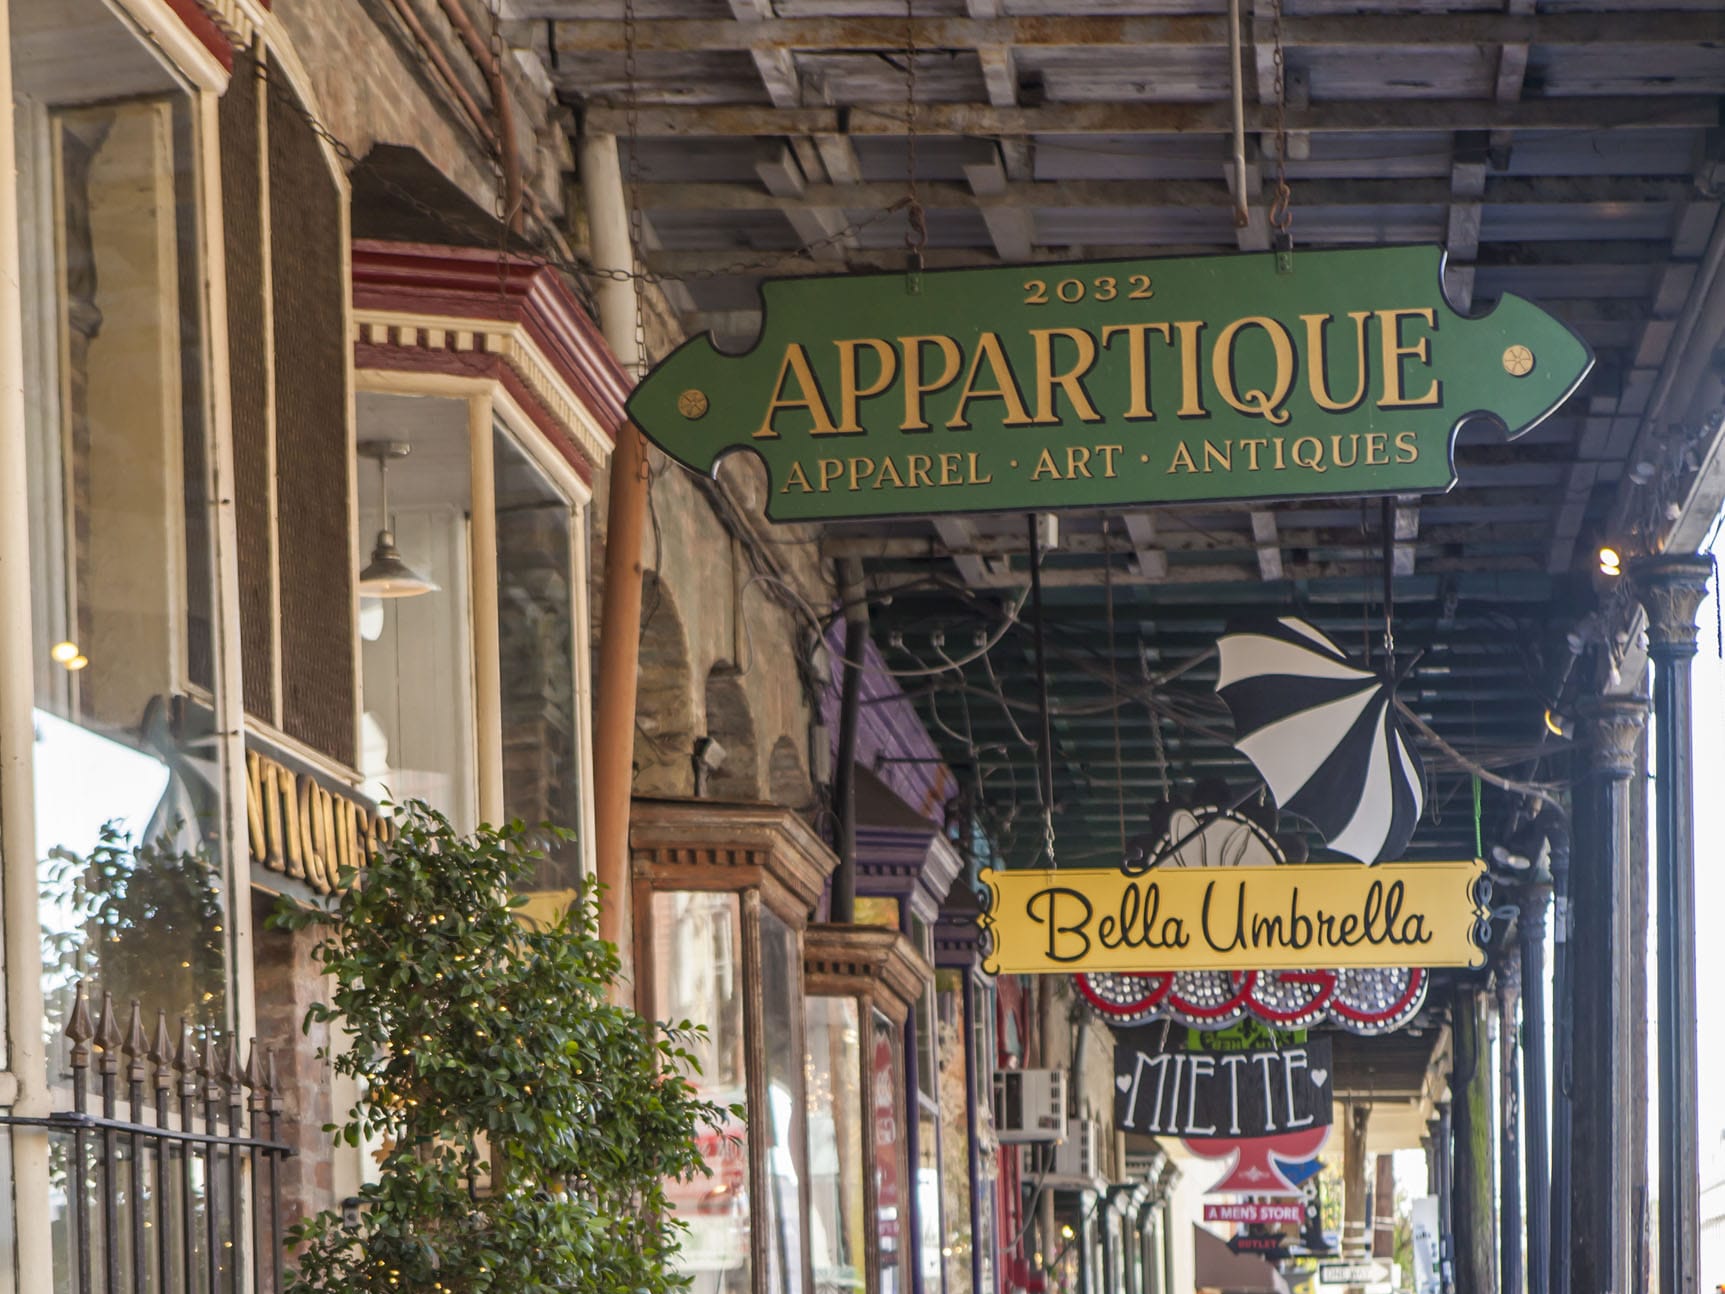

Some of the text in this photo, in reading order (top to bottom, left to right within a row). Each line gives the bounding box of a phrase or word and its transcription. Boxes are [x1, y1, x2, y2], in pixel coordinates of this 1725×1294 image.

[1024, 274, 1153, 304] 2032
[751, 307, 1439, 439] APPARTIQUE
[780, 432, 1419, 493] APPAREL ART ANTIQUES
[1026, 880, 1432, 962] Bella Umbrella
[1123, 1049, 1314, 1136] MIETTE
[1208, 1207, 1218, 1219] A
[1261, 1206, 1299, 1219] STORE
